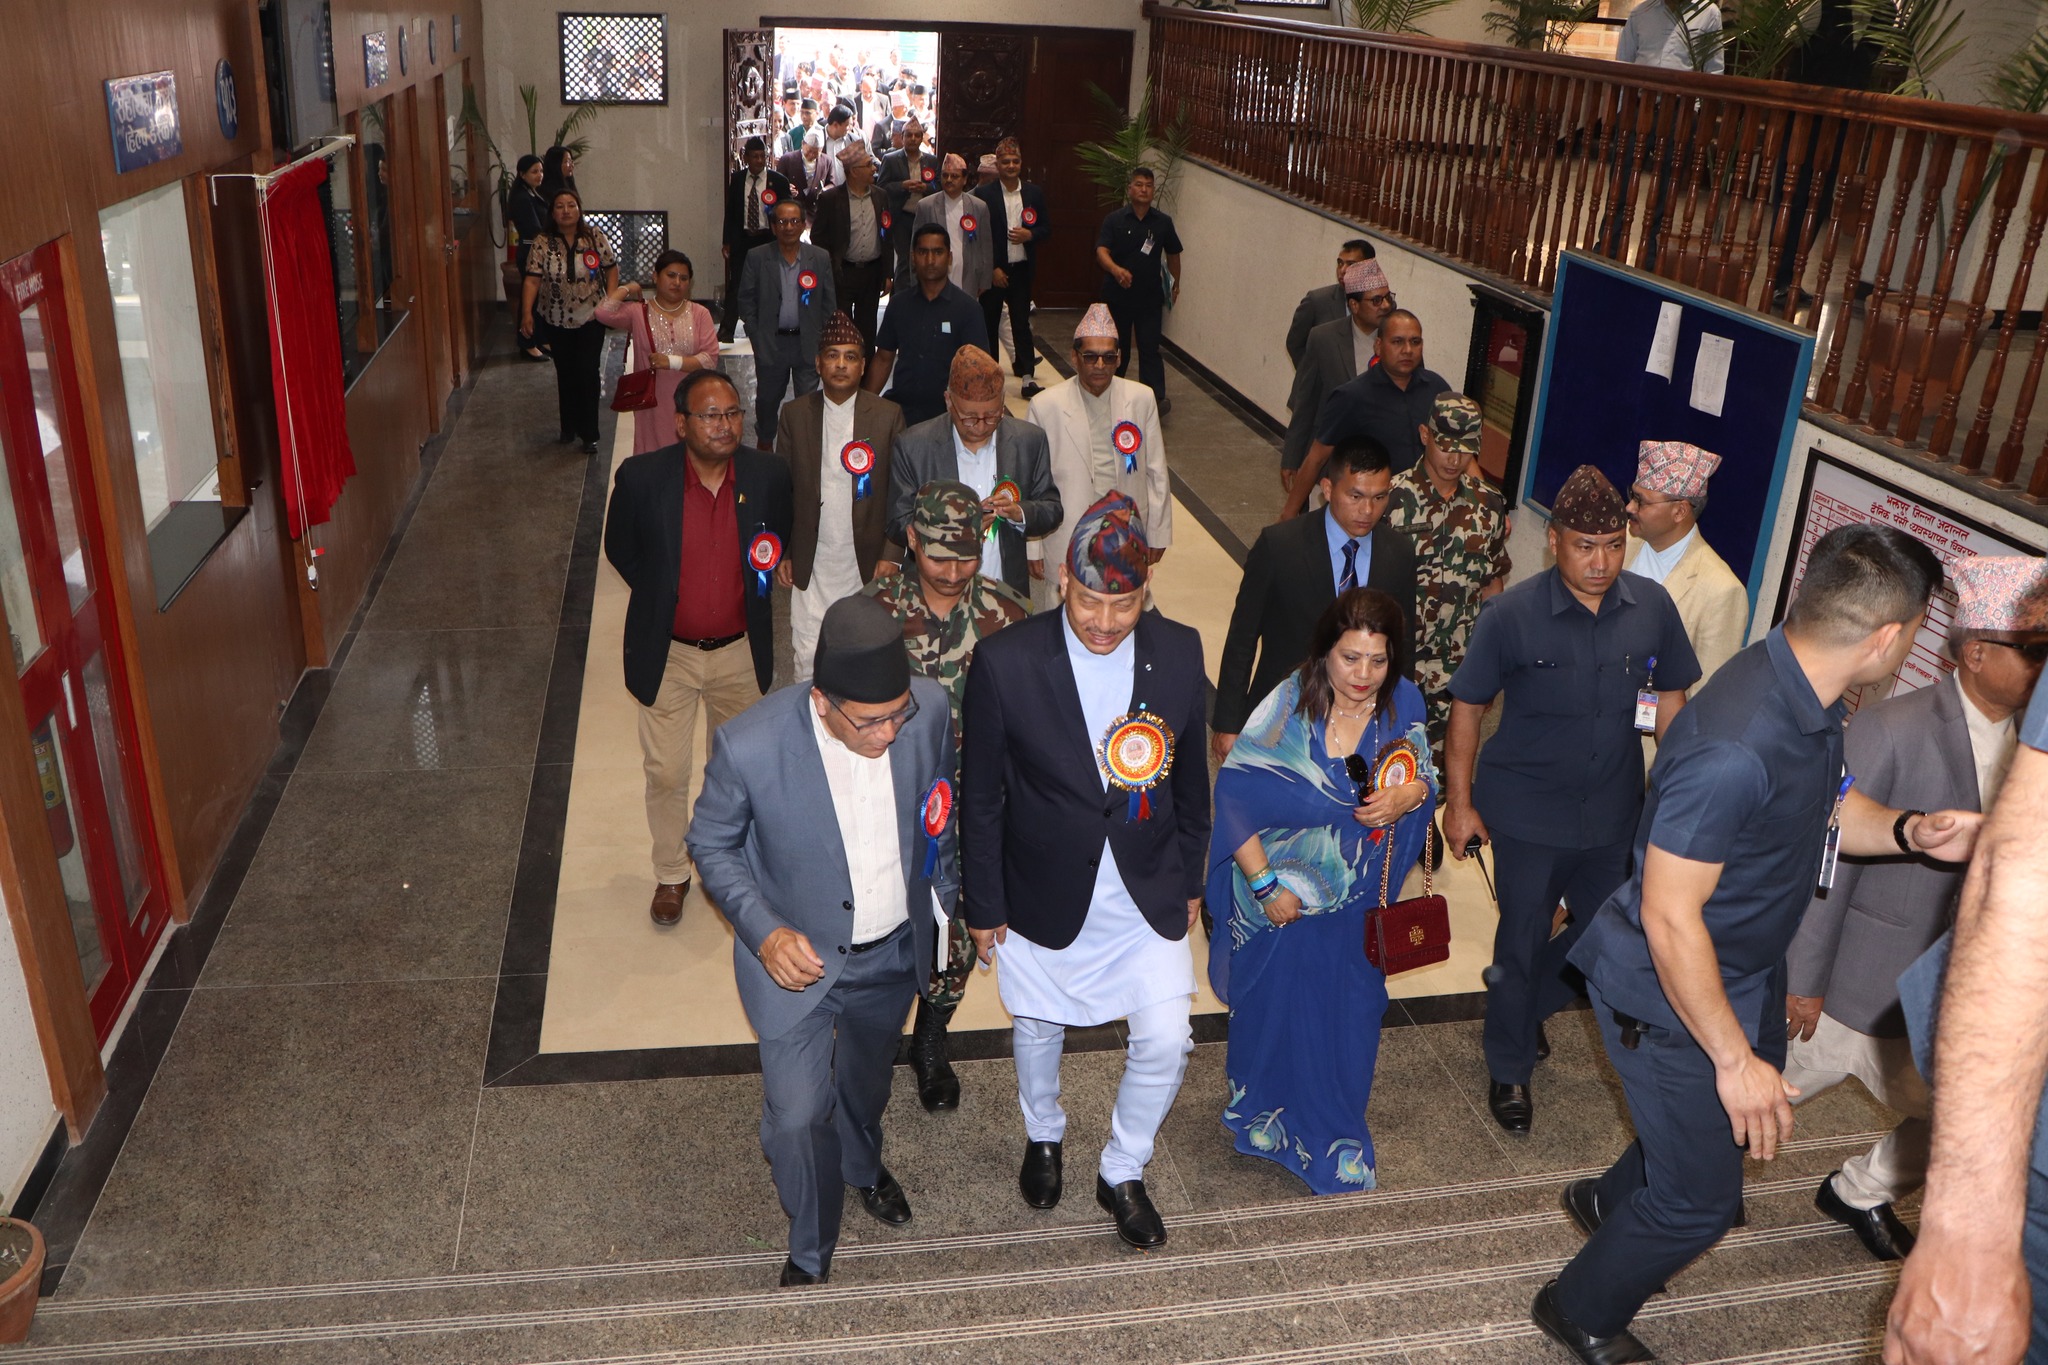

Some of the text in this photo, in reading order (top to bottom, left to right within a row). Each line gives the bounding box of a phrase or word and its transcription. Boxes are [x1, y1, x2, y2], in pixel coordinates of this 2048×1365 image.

[1870, 502, 1890, 520] दैनिक
[1912, 505, 1936, 525] जिल्ला
[1937, 519, 1969, 541] अदालत
